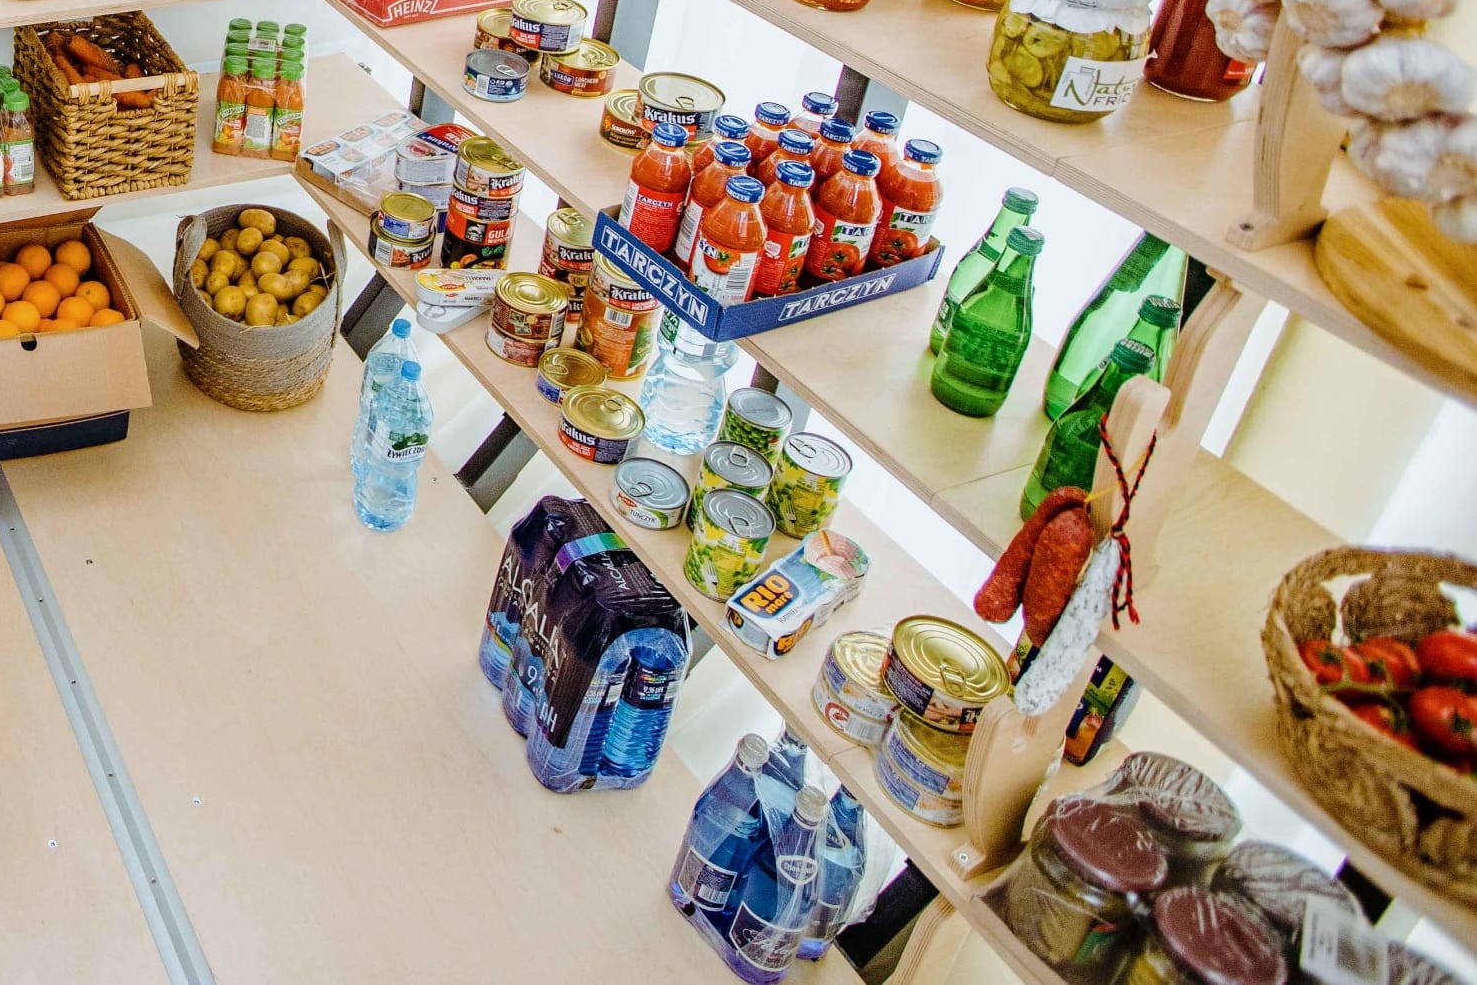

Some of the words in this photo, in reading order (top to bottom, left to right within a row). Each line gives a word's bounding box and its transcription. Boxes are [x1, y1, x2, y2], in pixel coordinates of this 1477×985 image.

[510, 18, 541, 33] rakus
[644, 105, 697, 125] Krakus
[452, 189, 479, 205] rakus
[637, 194, 674, 208] TARCZYN
[605, 229, 706, 324] TARCZYN
[784, 275, 894, 318] TARCZYN
[561, 421, 596, 446] rakus
[628, 507, 656, 524] TUŃCZYK
[740, 574, 790, 613] RIO
[765, 591, 794, 615] mare
